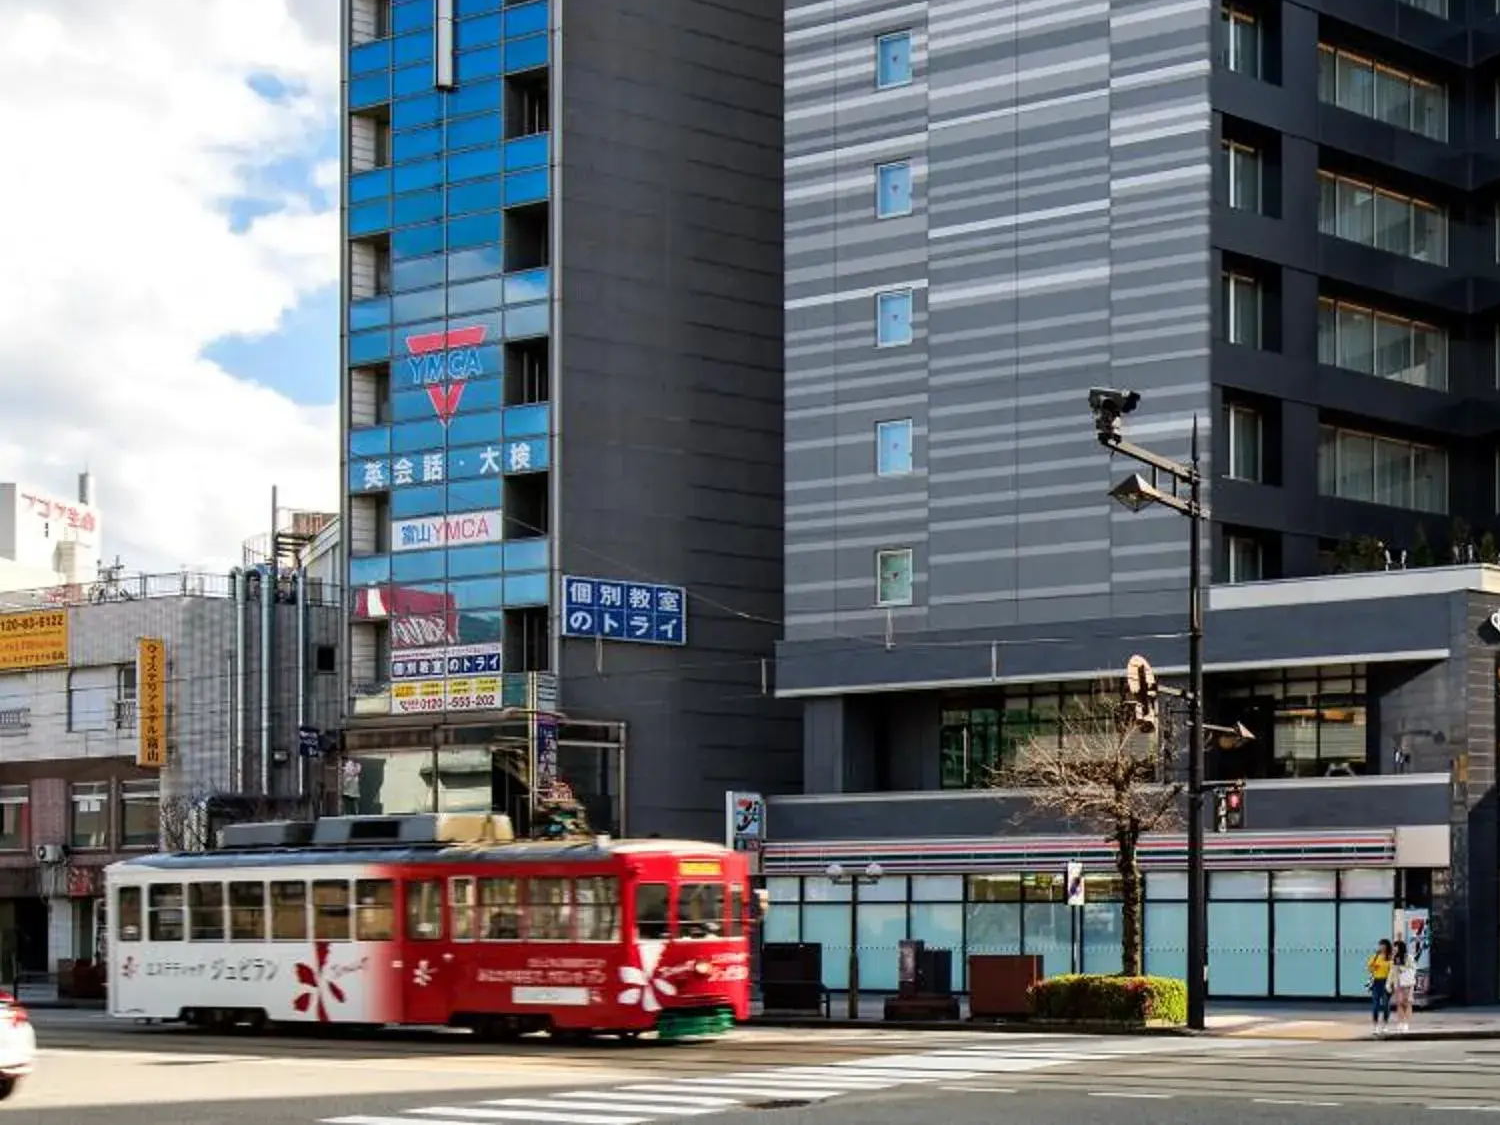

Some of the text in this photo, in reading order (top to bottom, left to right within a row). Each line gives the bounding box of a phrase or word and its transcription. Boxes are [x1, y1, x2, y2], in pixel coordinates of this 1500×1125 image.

[407, 349, 484, 384] YMCA
[401, 517, 489, 545] 富山YMCA
[570, 582, 679, 612] 個別教室
[570, 611, 677, 638] のトライ
